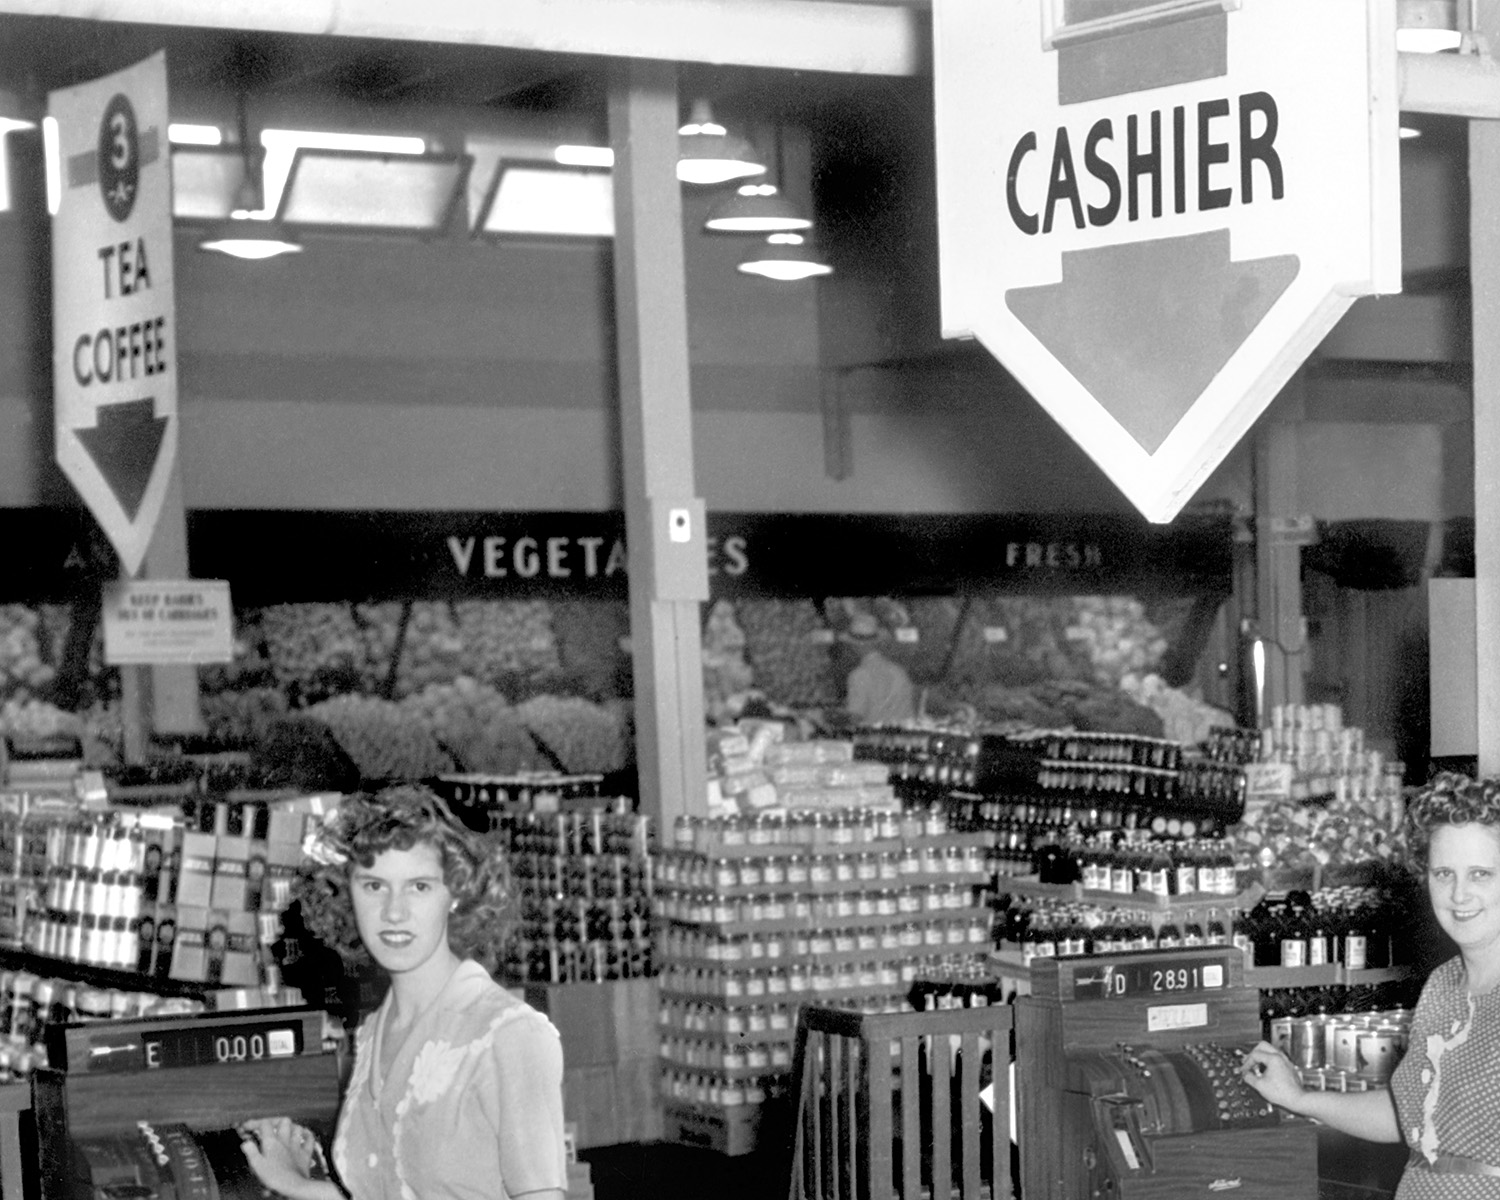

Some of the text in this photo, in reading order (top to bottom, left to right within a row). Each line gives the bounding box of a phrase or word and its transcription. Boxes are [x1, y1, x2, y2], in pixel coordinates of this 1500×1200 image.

[111, 113, 129, 169] 3
[1006, 91, 1284, 236] CASHIER
[97, 237, 152, 299] TEA
[72, 316, 167, 388] COFFEE
[1006, 542, 1100, 567] FRESH
[1115, 974, 1126, 995] D
[146, 1042, 161, 1068] E
